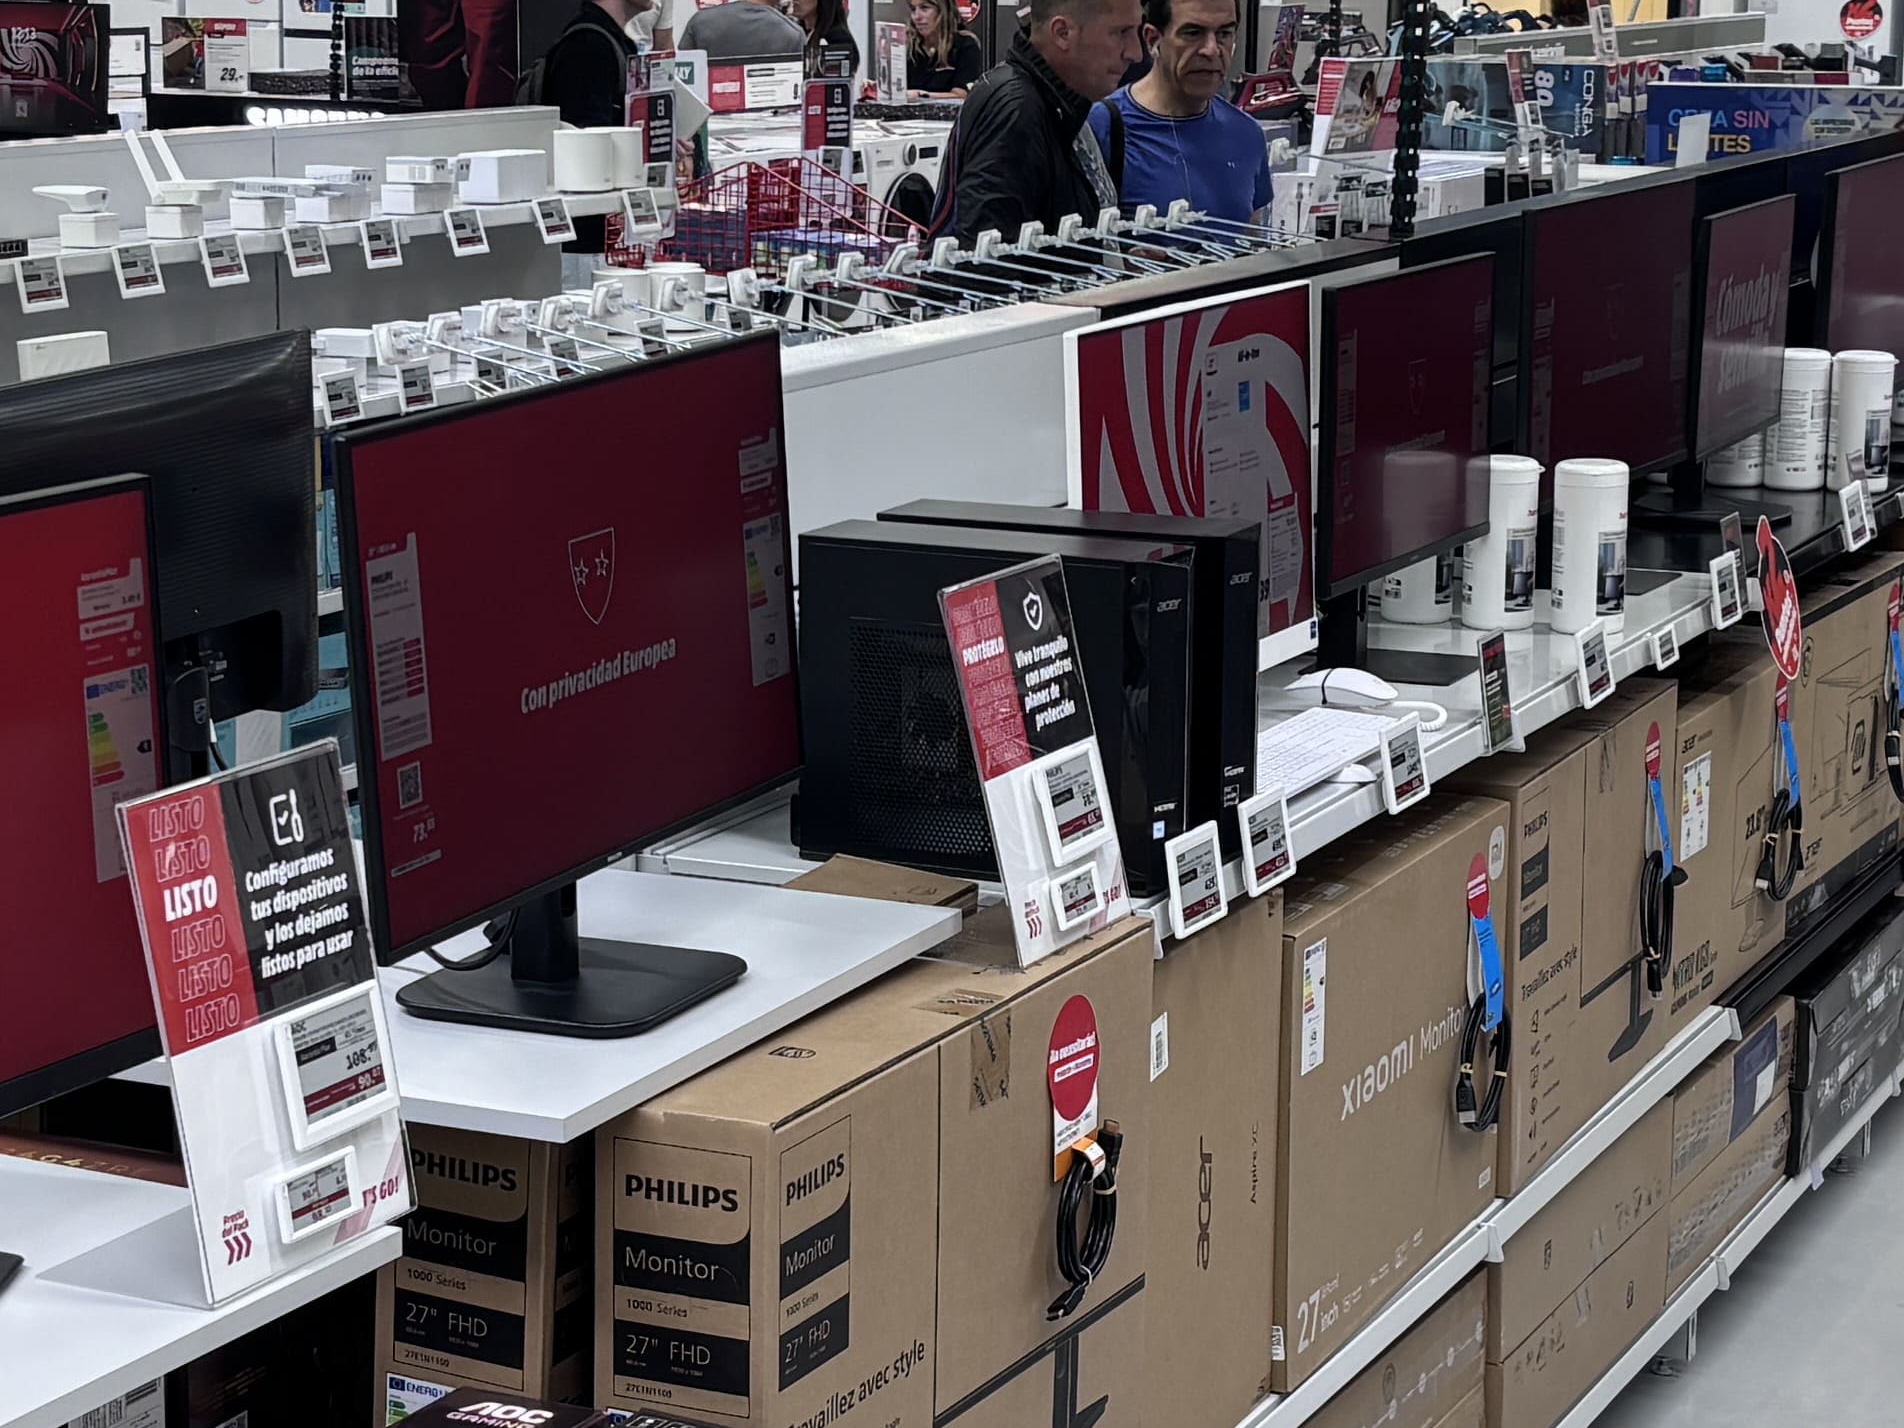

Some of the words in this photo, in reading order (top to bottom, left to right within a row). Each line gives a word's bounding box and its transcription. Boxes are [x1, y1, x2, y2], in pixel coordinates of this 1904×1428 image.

[1582, 69, 1594, 137] CONGA
[1733, 110, 1770, 128] SIN
[1156, 597, 1182, 613] acer
[520, 684, 547, 714] Con
[548, 654, 622, 709] privacidad
[623, 638, 677, 682] Europea
[149, 796, 204, 842] LISTO
[155, 835, 211, 883] LISTO
[245, 847, 334, 893] Configuramos
[163, 875, 217, 922] LISTO
[251, 897, 272, 922] tus
[273, 871, 348, 918] dispositivos
[171, 915, 225, 963] LISTO
[277, 918, 294, 944] los
[295, 901, 349, 942] dejamos
[262, 948, 295, 979] listos
[297, 941, 325, 970] para
[326, 928, 354, 955] usar
[179, 954, 233, 1003] LISTO
[186, 993, 240, 1043] LISTO
[1420, 1005, 1465, 1054] Monitor
[625, 1172, 740, 1214] PHILIPS
[785, 1153, 846, 1207] PHILIPS
[1197, 1135, 1212, 1271] acer
[407, 1219, 497, 1257] Monitor
[785, 1231, 836, 1278] Monitor
[407, 1268, 433, 1286] 1000
[435, 1273, 468, 1292] Series
[624, 1247, 721, 1282] Monitor
[448, 1313, 488, 1339] FHD
[626, 1297, 653, 1314] 1000
[656, 1301, 688, 1319] Series
[1297, 1289, 1321, 1354] 27
[670, 1341, 711, 1367] FHD
[808, 1318, 831, 1347] FHD
[859, 1372, 891, 1404] avec
[892, 1338, 926, 1385] style
[459, 1401, 554, 1426] AOC
